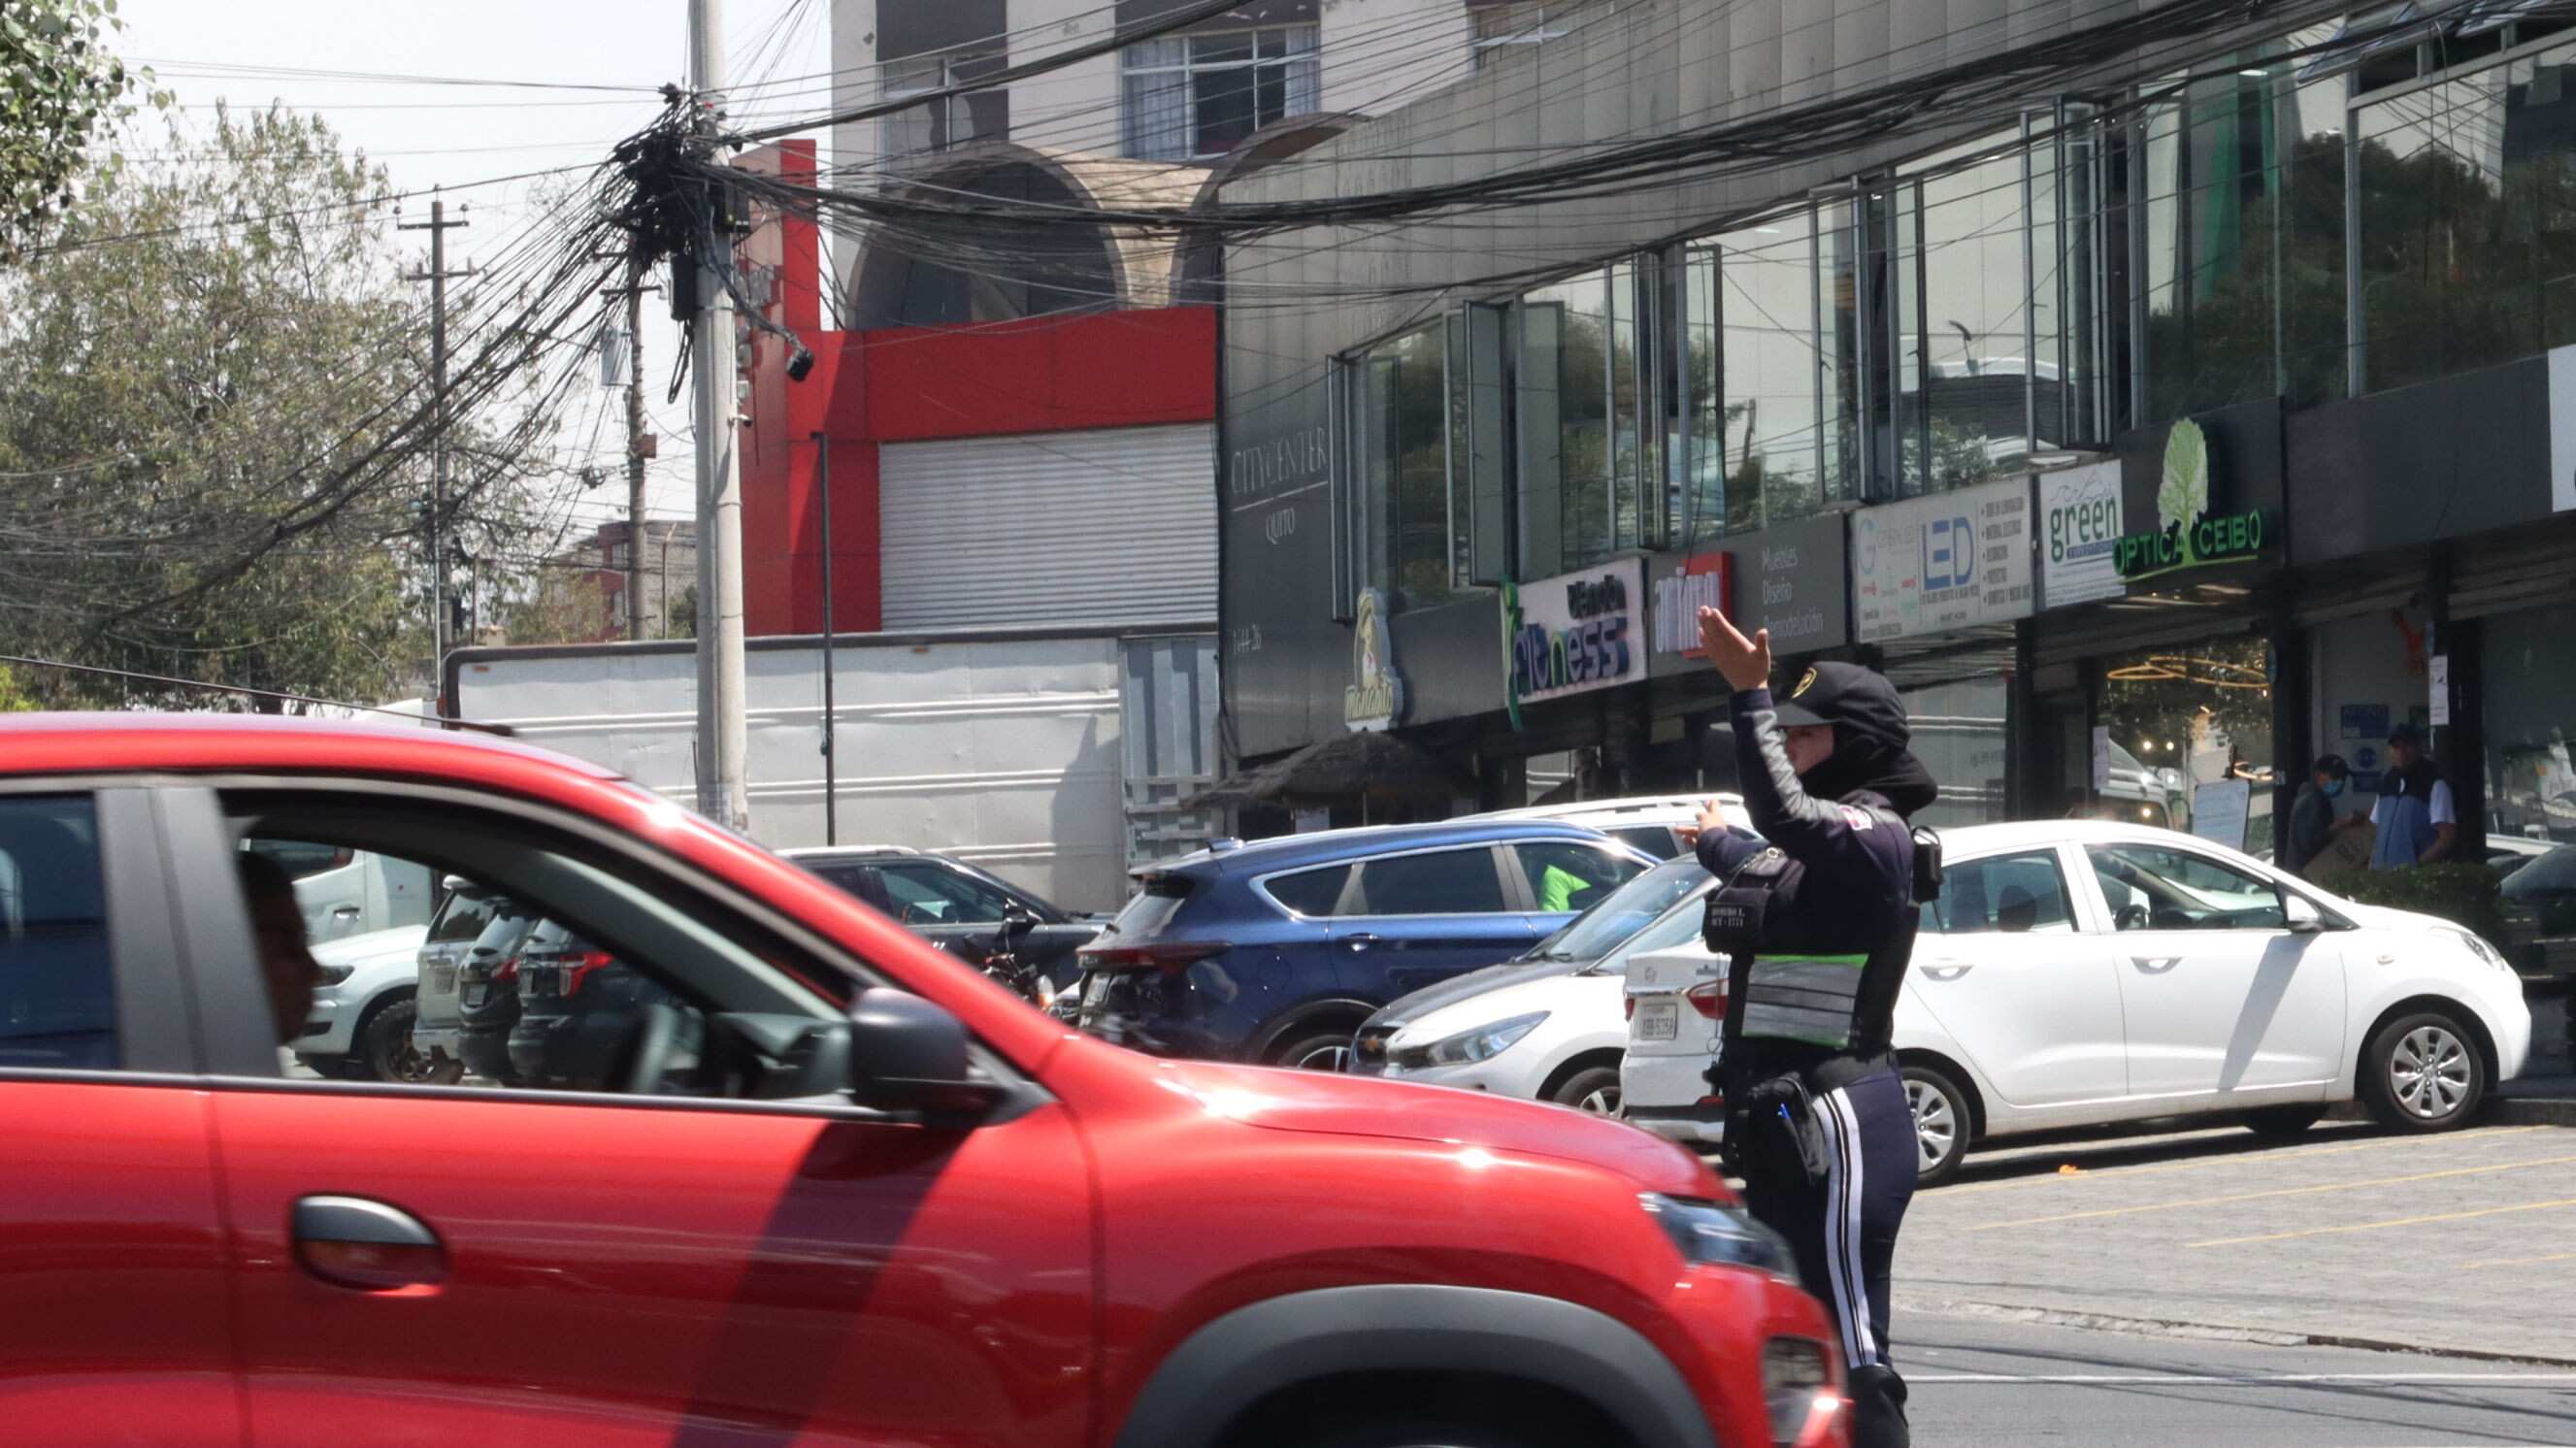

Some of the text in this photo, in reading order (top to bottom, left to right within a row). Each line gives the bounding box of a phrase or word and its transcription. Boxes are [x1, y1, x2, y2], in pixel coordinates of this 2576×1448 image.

[1266, 507, 1296, 544] QUITO
[1921, 516, 1973, 591] LED
[2050, 496, 2118, 562] green
[2112, 533, 2184, 576] OPTICA
[2197, 509, 2263, 556] CEIBO
